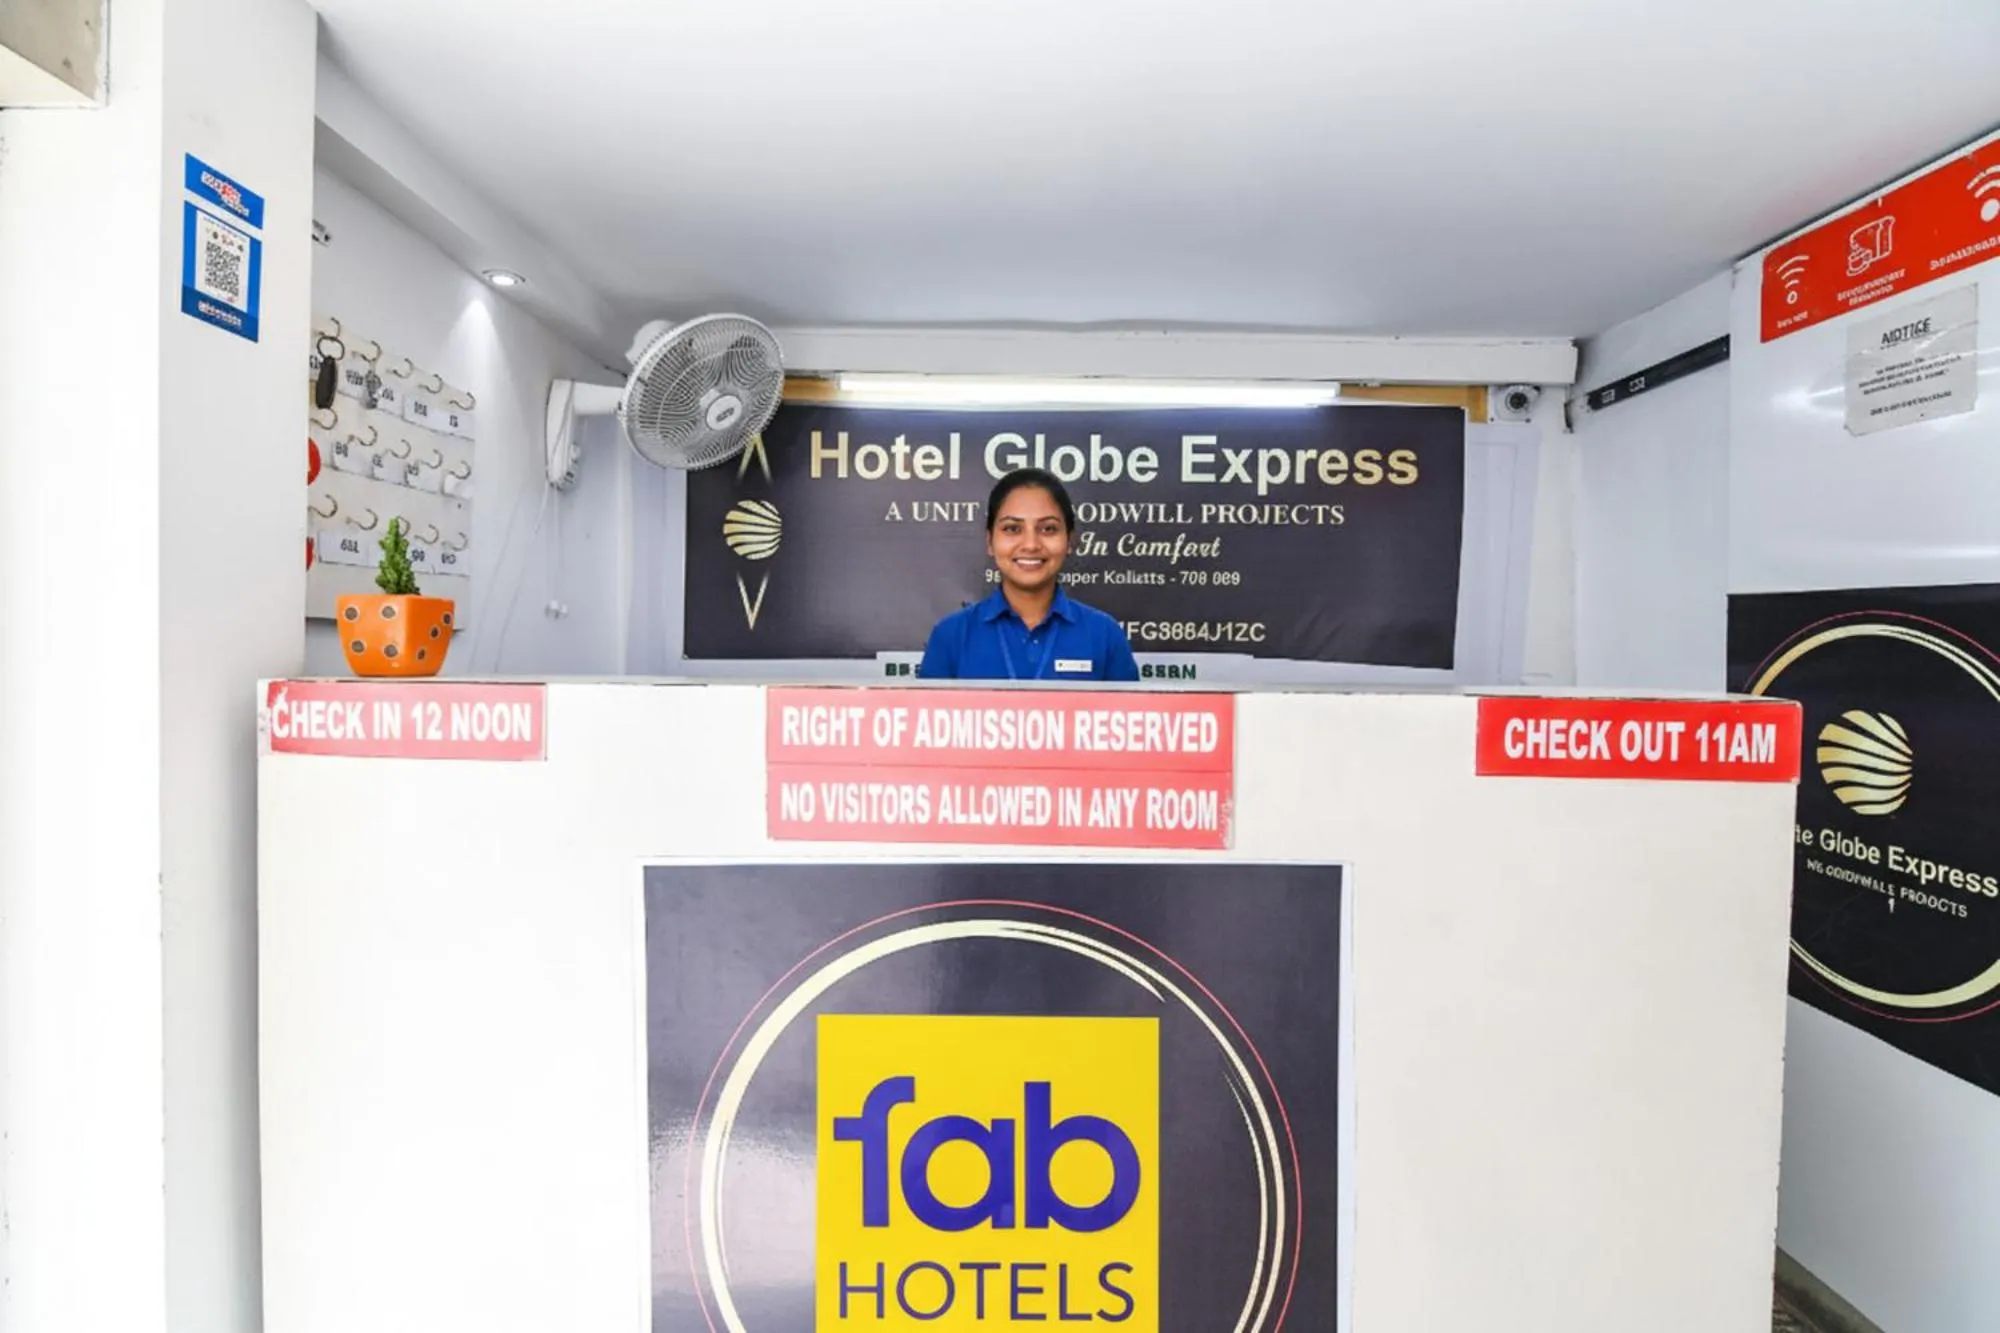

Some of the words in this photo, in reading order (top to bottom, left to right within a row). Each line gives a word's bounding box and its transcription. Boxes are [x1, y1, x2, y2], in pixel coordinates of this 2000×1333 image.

[1880, 317, 1931, 345] NOTICE
[809, 431, 961, 480] Hotel
[983, 432, 1159, 483] Globe
[1180, 434, 1418, 496] Express
[885, 503, 903, 521] A
[911, 502, 980, 522] UNIT
[1200, 504, 1345, 525] PROJECTS
[272, 700, 366, 740] CHECK
[373, 702, 401, 740] IN
[410, 702, 443, 740] 12
[451, 702, 533, 741] NOON
[781, 707, 865, 747] RIGHT
[873, 709, 908, 747] OF
[913, 709, 1065, 750] ADMISSION
[1074, 711, 1218, 753] RESERVED
[1504, 717, 1612, 761] CHECK
[1620, 720, 1686, 762] OUT
[1695, 722, 1777, 763] 11AM
[780, 782, 816, 822] NO
[821, 783, 931, 824] VISITORS
[938, 786, 1050, 826] ALLOWED
[1058, 788, 1083, 826] IN
[1087, 789, 1139, 828] ANY
[1146, 789, 1218, 831] ROOM
[1819, 828, 1881, 865] Globe
[1887, 844, 1999, 898] Express
[833, 1075, 1141, 1233] fab
[838, 1260, 1136, 1322] HOTELS
